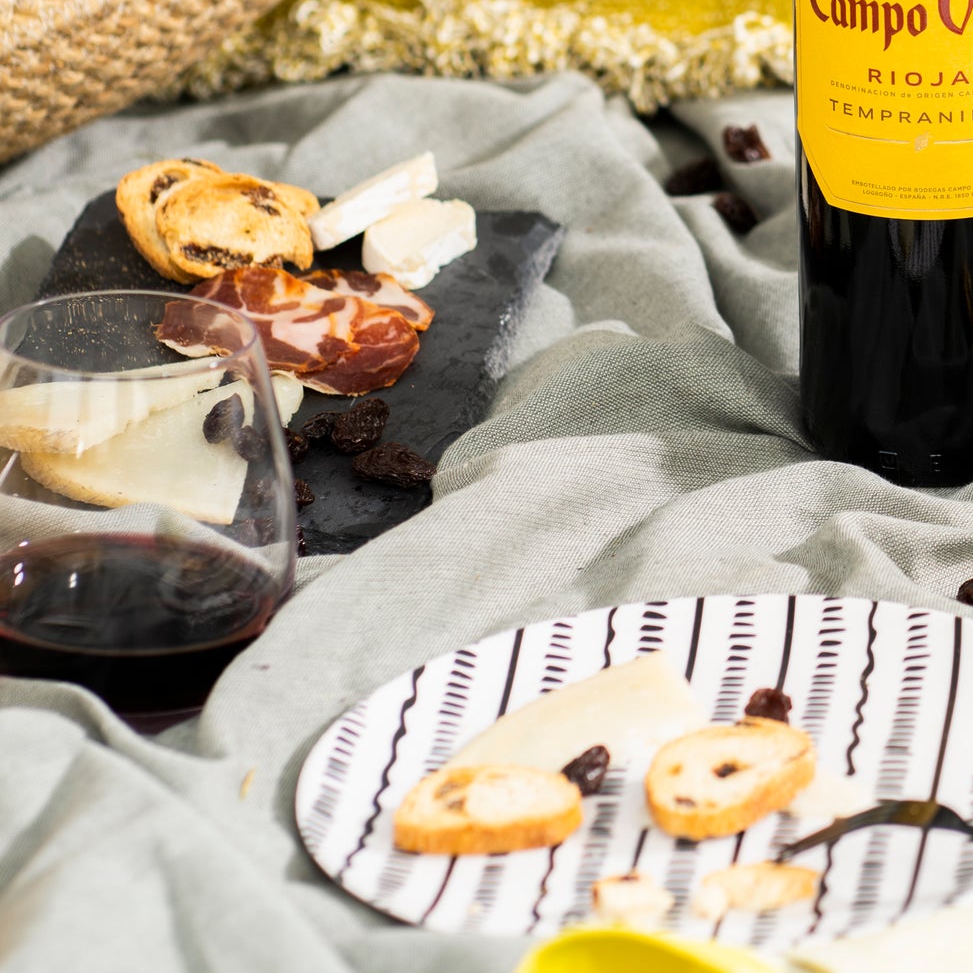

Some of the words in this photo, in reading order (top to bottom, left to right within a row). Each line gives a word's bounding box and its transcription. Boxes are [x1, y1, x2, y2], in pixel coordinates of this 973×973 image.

[868, 68, 970, 87] RIOJA
[851, 180, 896, 191] EMBOTELLADO
[862, 189, 893, 198] LOGROÑO
